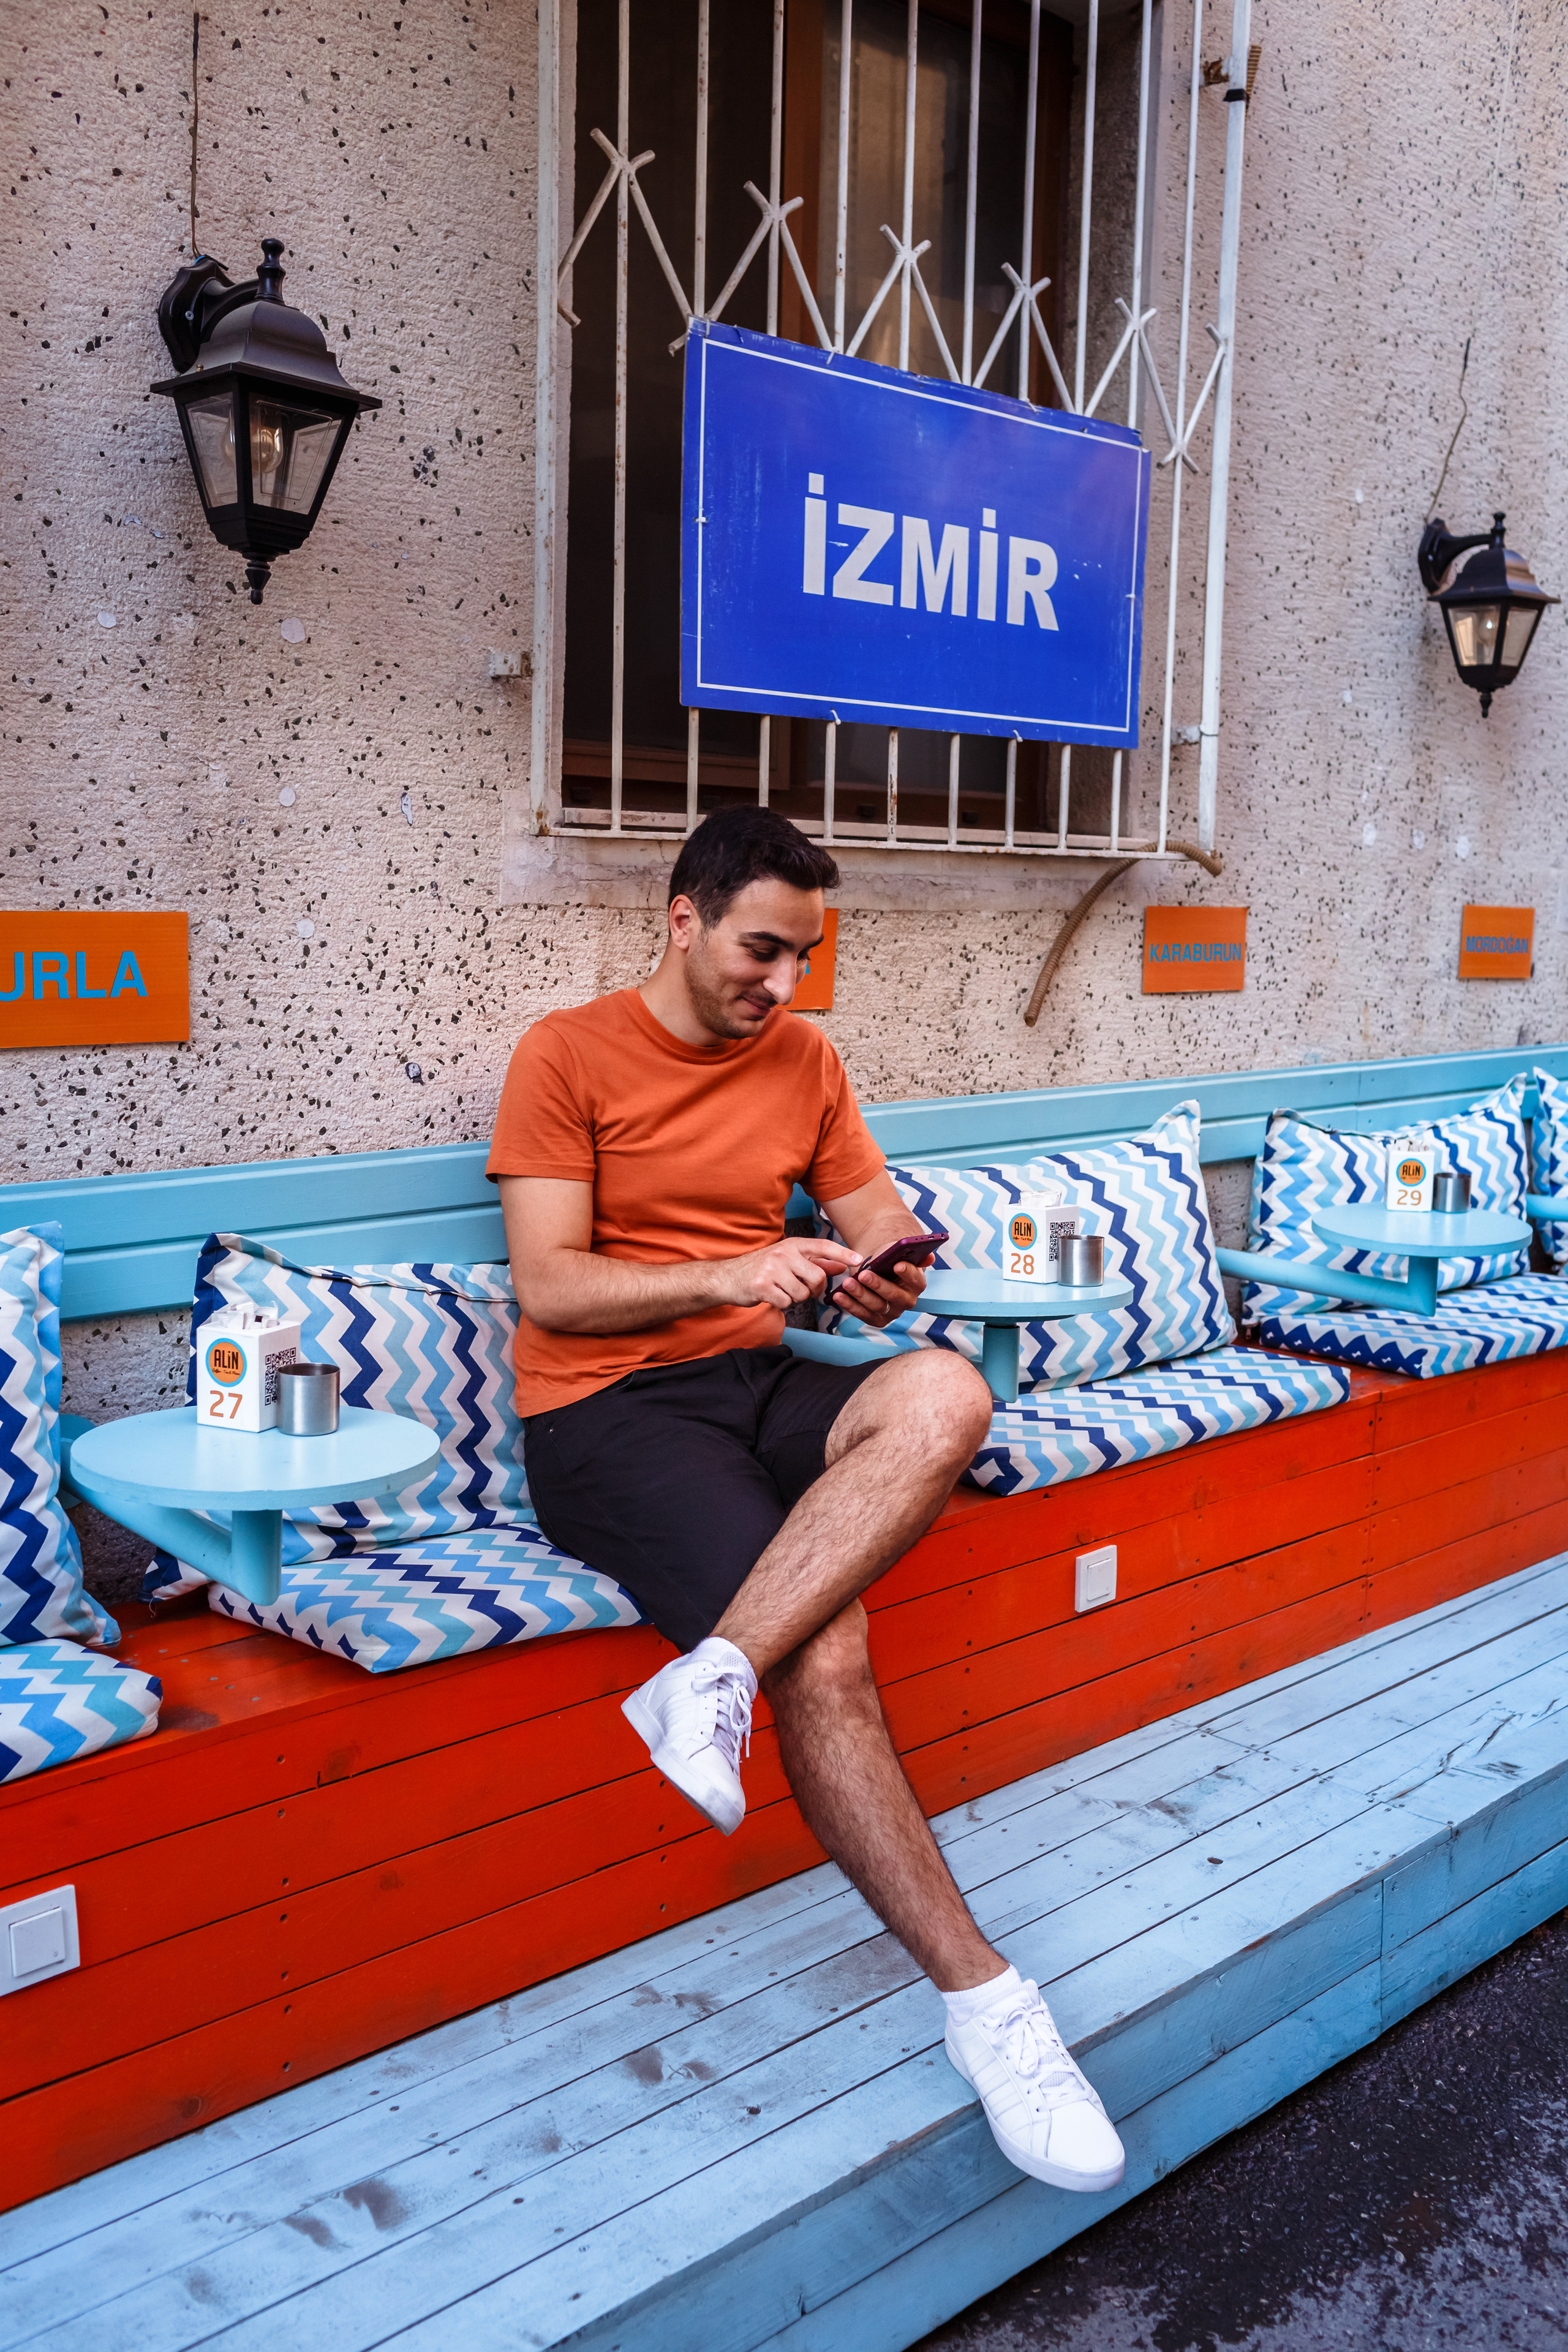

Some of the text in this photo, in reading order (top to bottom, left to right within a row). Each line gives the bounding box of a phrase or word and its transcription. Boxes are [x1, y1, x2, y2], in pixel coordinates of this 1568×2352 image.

[803, 472, 1059, 631] İZMİR
[1150, 943, 1241, 962] KARABURUN
[0, 951, 148, 1001] URLA
[1397, 1189, 1422, 1205] 29
[1011, 1253, 1035, 1275] 28
[209, 1390, 243, 1419] 27
